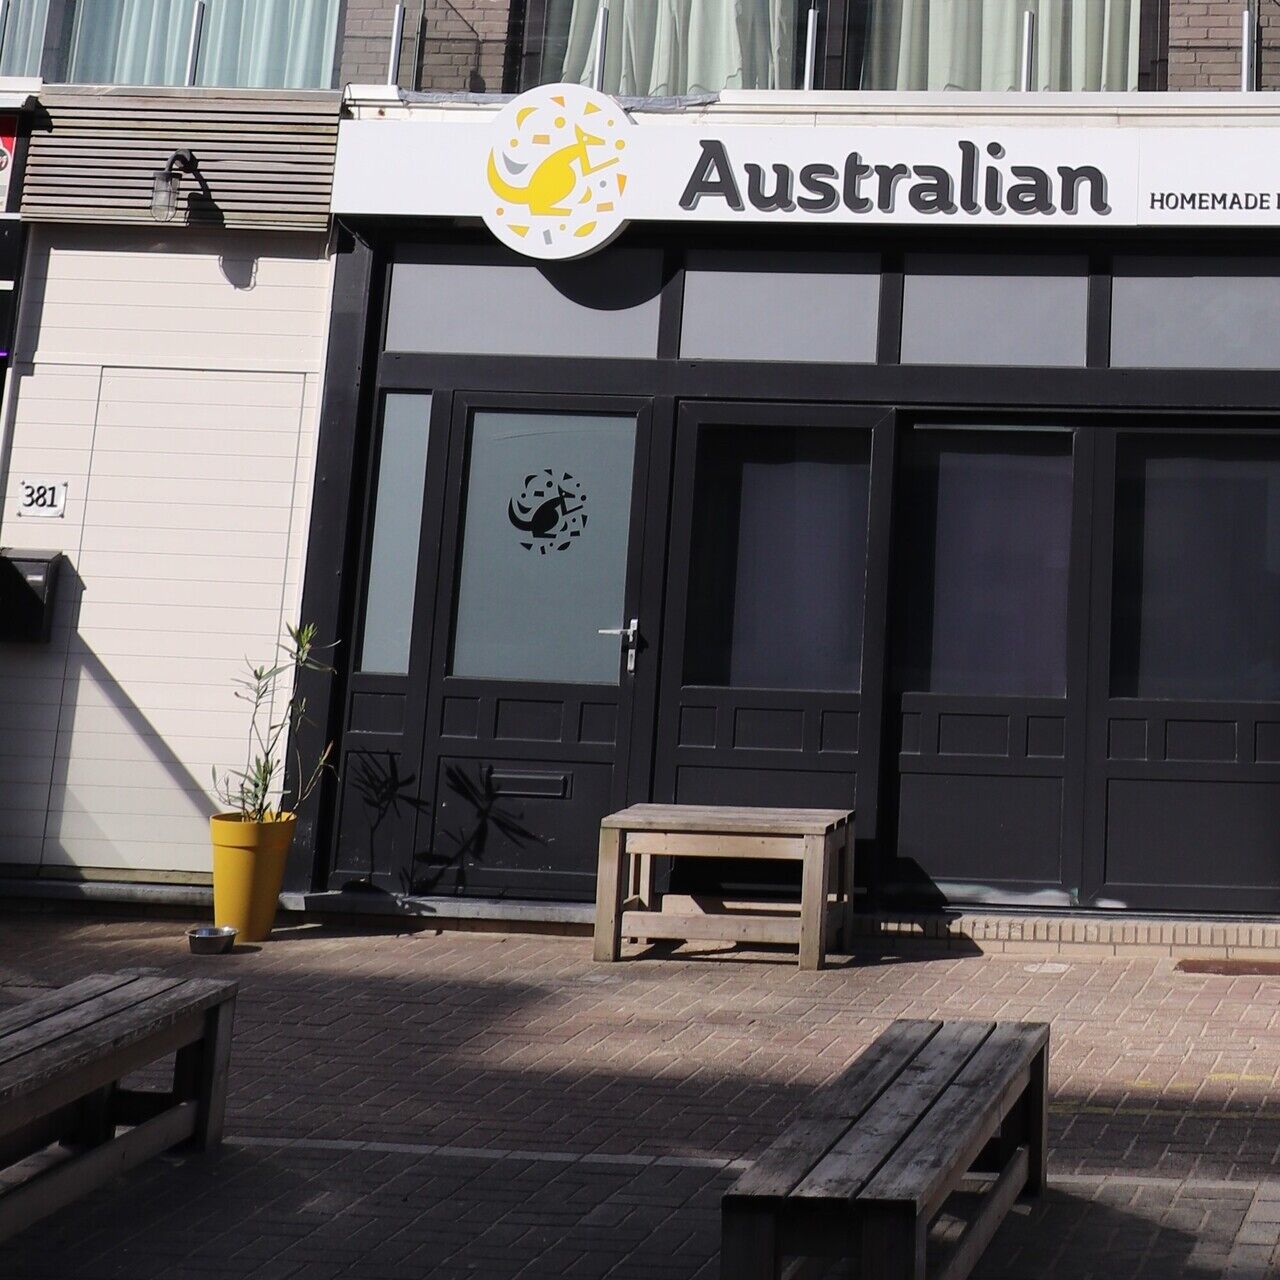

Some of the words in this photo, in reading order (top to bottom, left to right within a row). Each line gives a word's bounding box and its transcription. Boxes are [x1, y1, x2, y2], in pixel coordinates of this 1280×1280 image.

[678, 139, 1112, 216] Australian
[1149, 192, 1271, 211] HOMEMADE
[22, 485, 58, 508] 381
